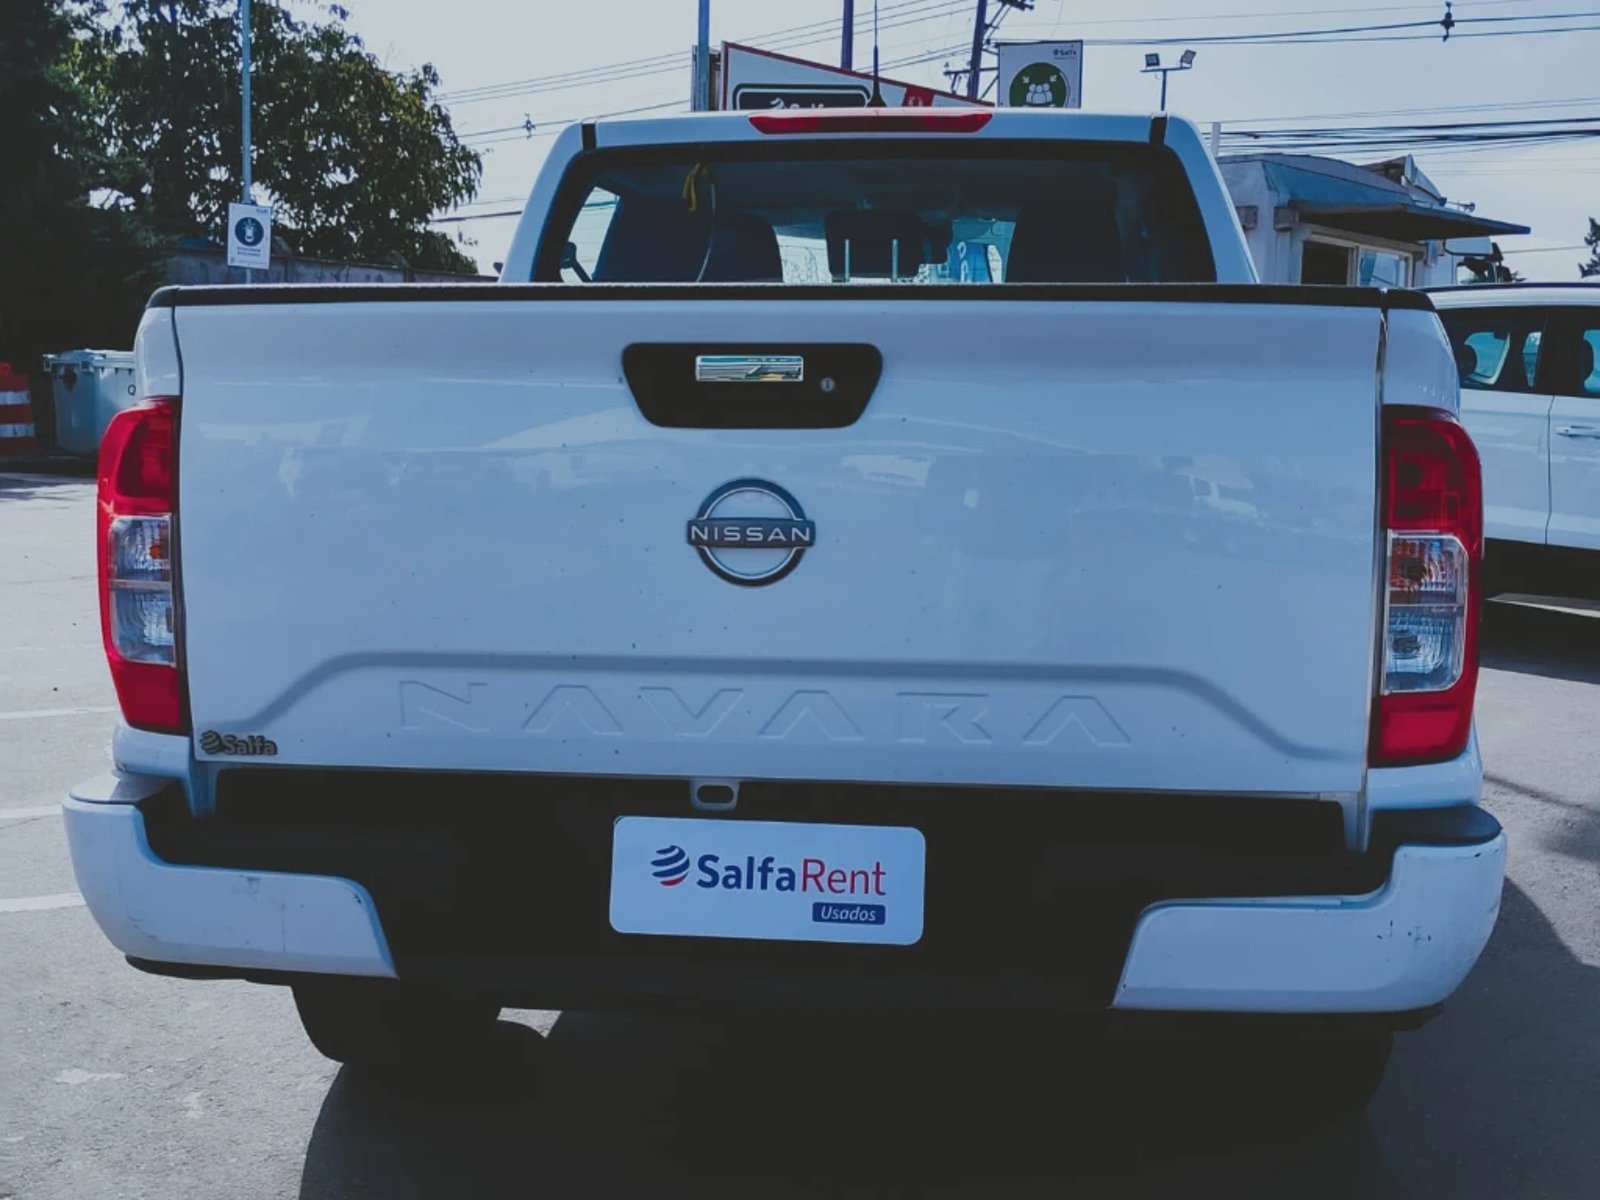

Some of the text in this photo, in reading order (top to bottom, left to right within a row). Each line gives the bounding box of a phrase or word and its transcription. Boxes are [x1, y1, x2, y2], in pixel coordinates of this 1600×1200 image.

[691, 526, 811, 542] NISSAN
[400, 680, 1131, 747] NAVARA
[223, 734, 278, 755] Salfa
[696, 854, 886, 896] SalfaRent
[820, 904, 876, 922] Usados
